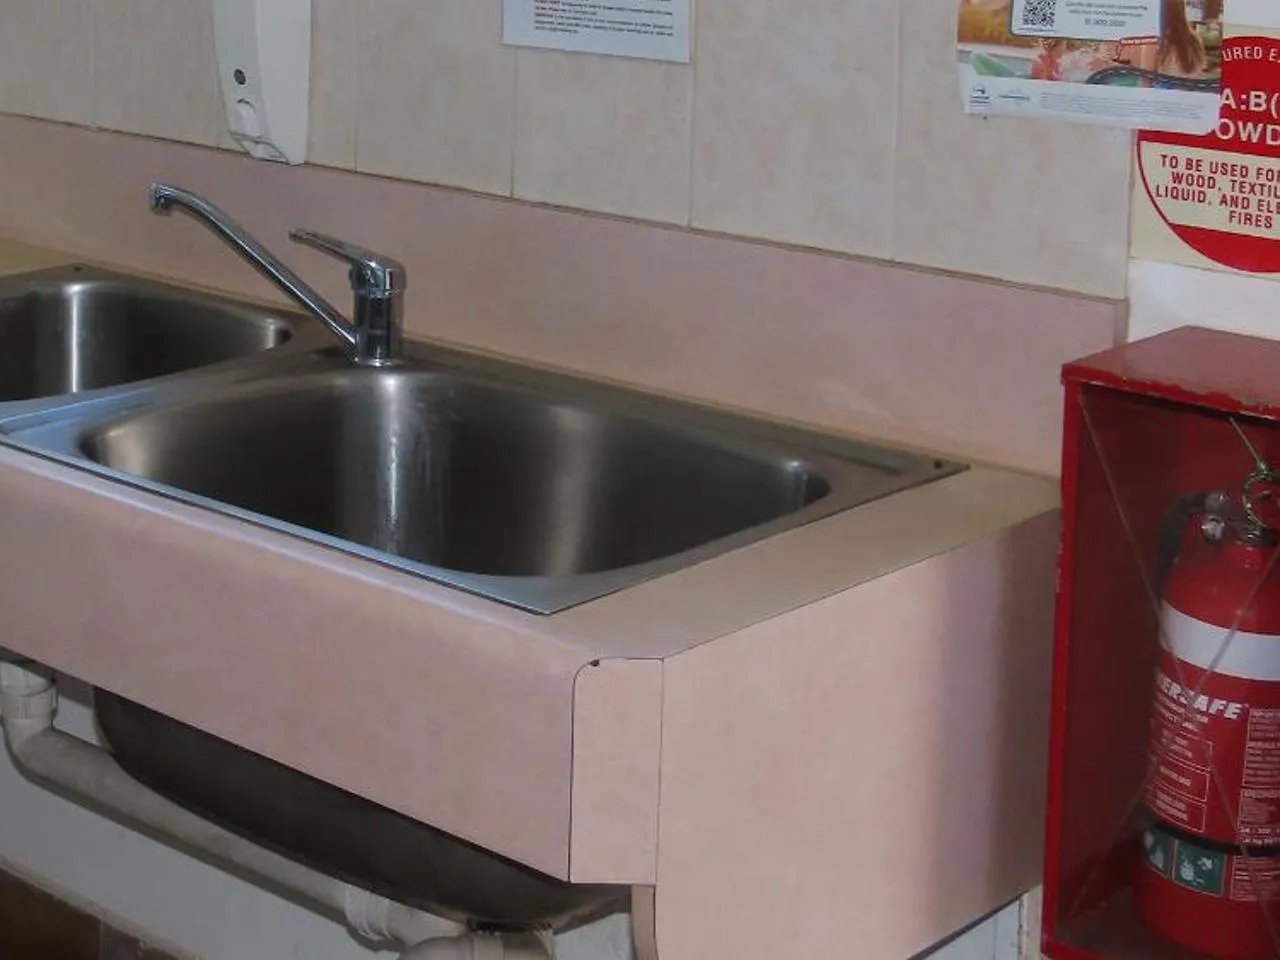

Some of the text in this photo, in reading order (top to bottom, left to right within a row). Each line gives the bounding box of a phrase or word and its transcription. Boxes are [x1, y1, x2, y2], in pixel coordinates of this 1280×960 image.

[1160, 154, 1178, 169] TO
[1185, 158, 1204, 173] BE
[1210, 162, 1249, 179] USED
[1220, 193, 1250, 210] AND
[1228, 210, 1273, 229] FIRES
